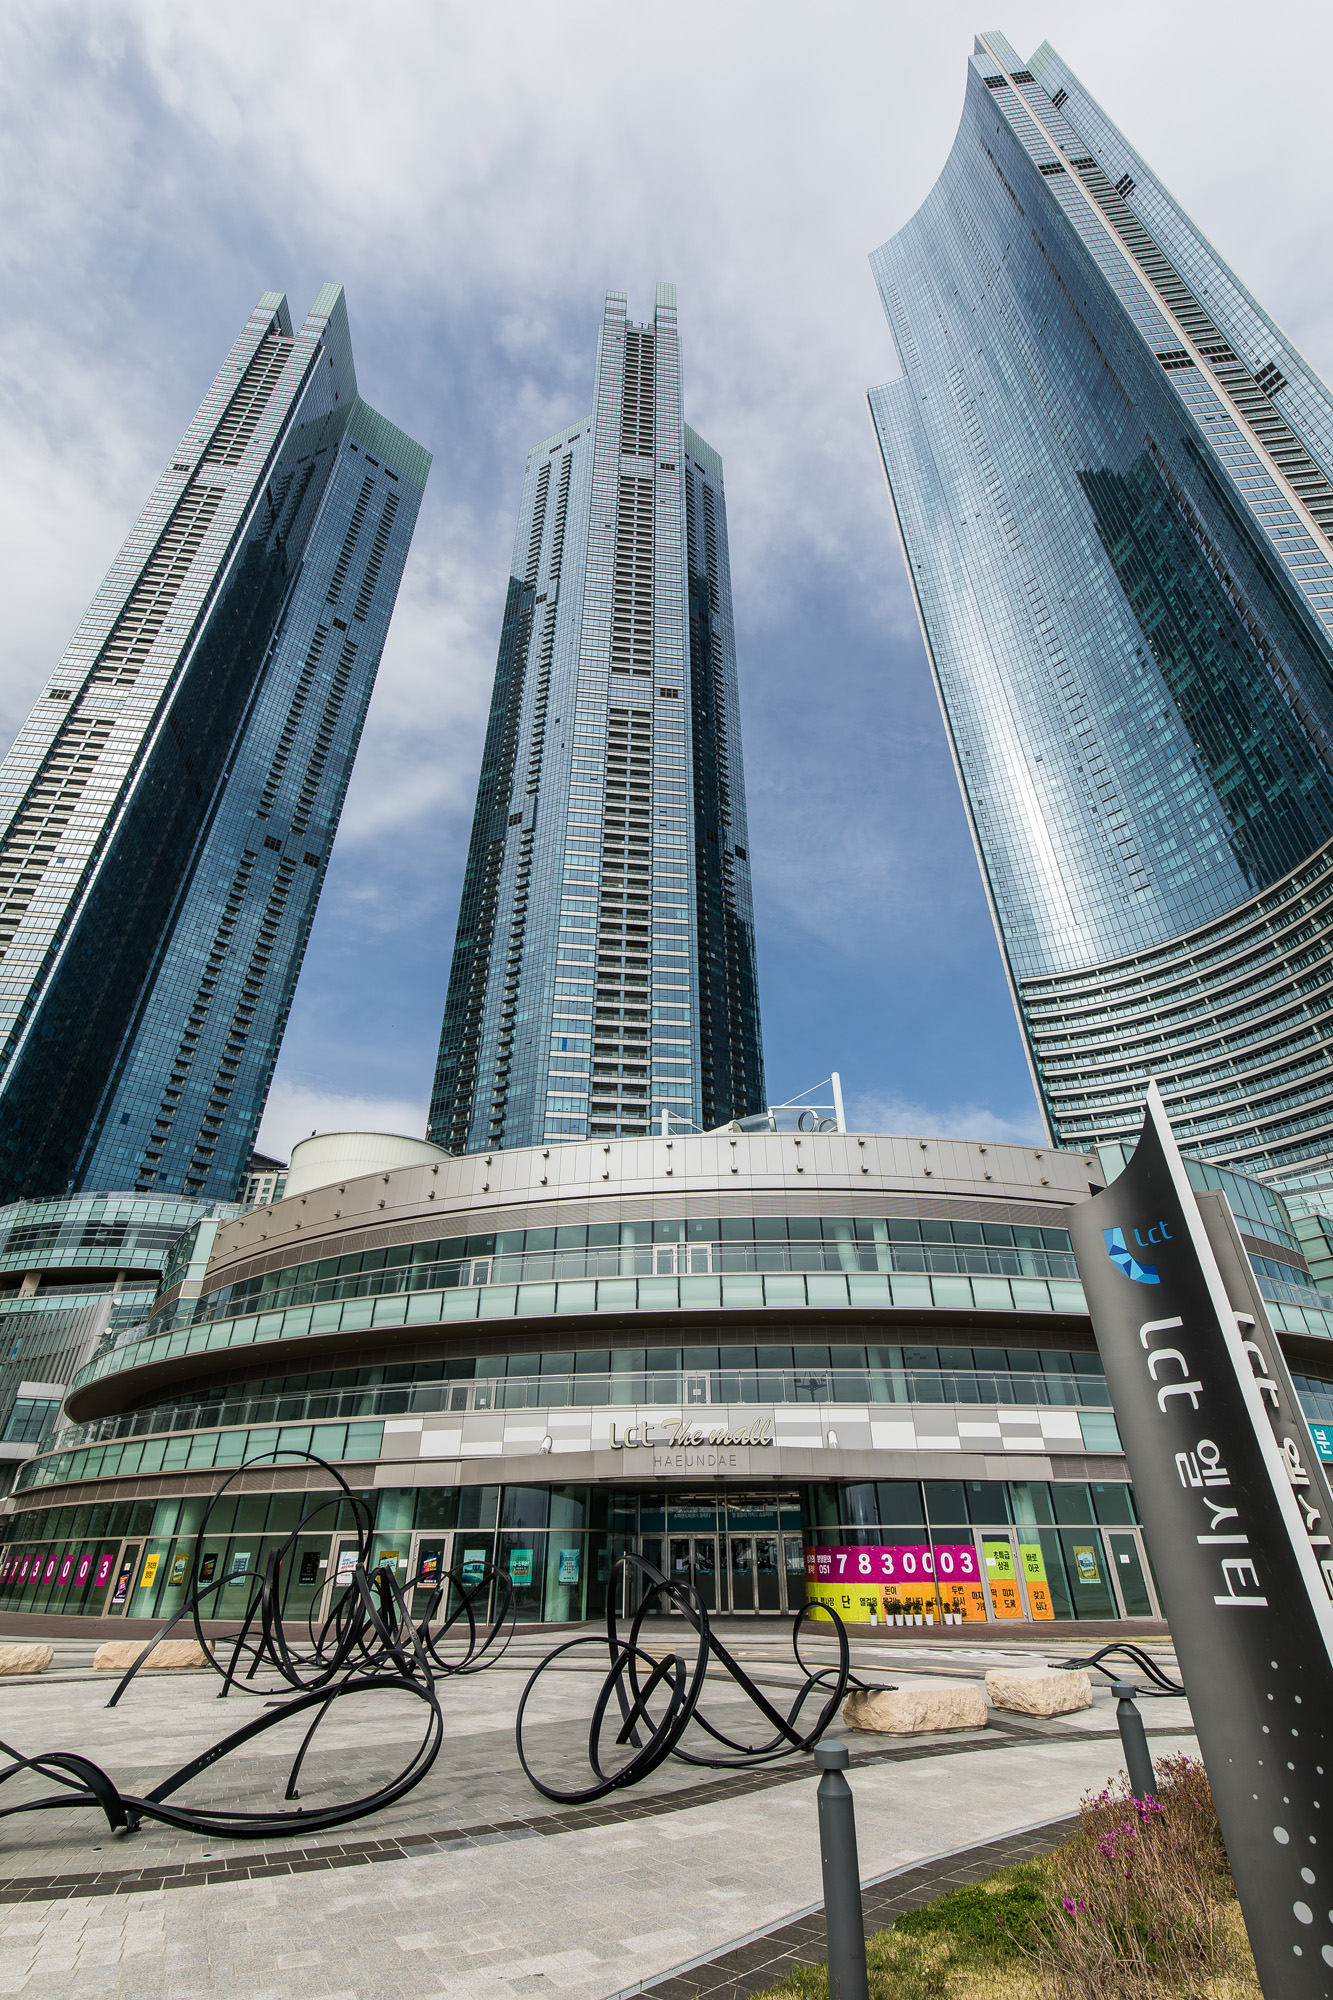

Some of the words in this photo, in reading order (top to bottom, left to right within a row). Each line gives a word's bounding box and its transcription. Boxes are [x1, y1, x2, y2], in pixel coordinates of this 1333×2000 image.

[661, 1418, 703, 1446] The
[709, 1416, 773, 1446] mall
[654, 1455, 737, 1467] HAEUNDAE
[1175, 1439, 1268, 1607] 엘시티
[993, 1551, 1010, 1560] 초특급
[1026, 1553, 1038, 1562] 바로
[819, 1565, 830, 1574] 051
[997, 1561, 1010, 1571] 상권
[1028, 1564, 1040, 1573] 이곳
[884, 1586, 897, 1595] 돈이
[952, 1586, 964, 1595] 두번
[1002, 1588, 1015, 1598] 미치
[1033, 1591, 1045, 1600] 갖고
[841, 1595, 851, 1609] 단
[1004, 1599, 1017, 1609] 도록
